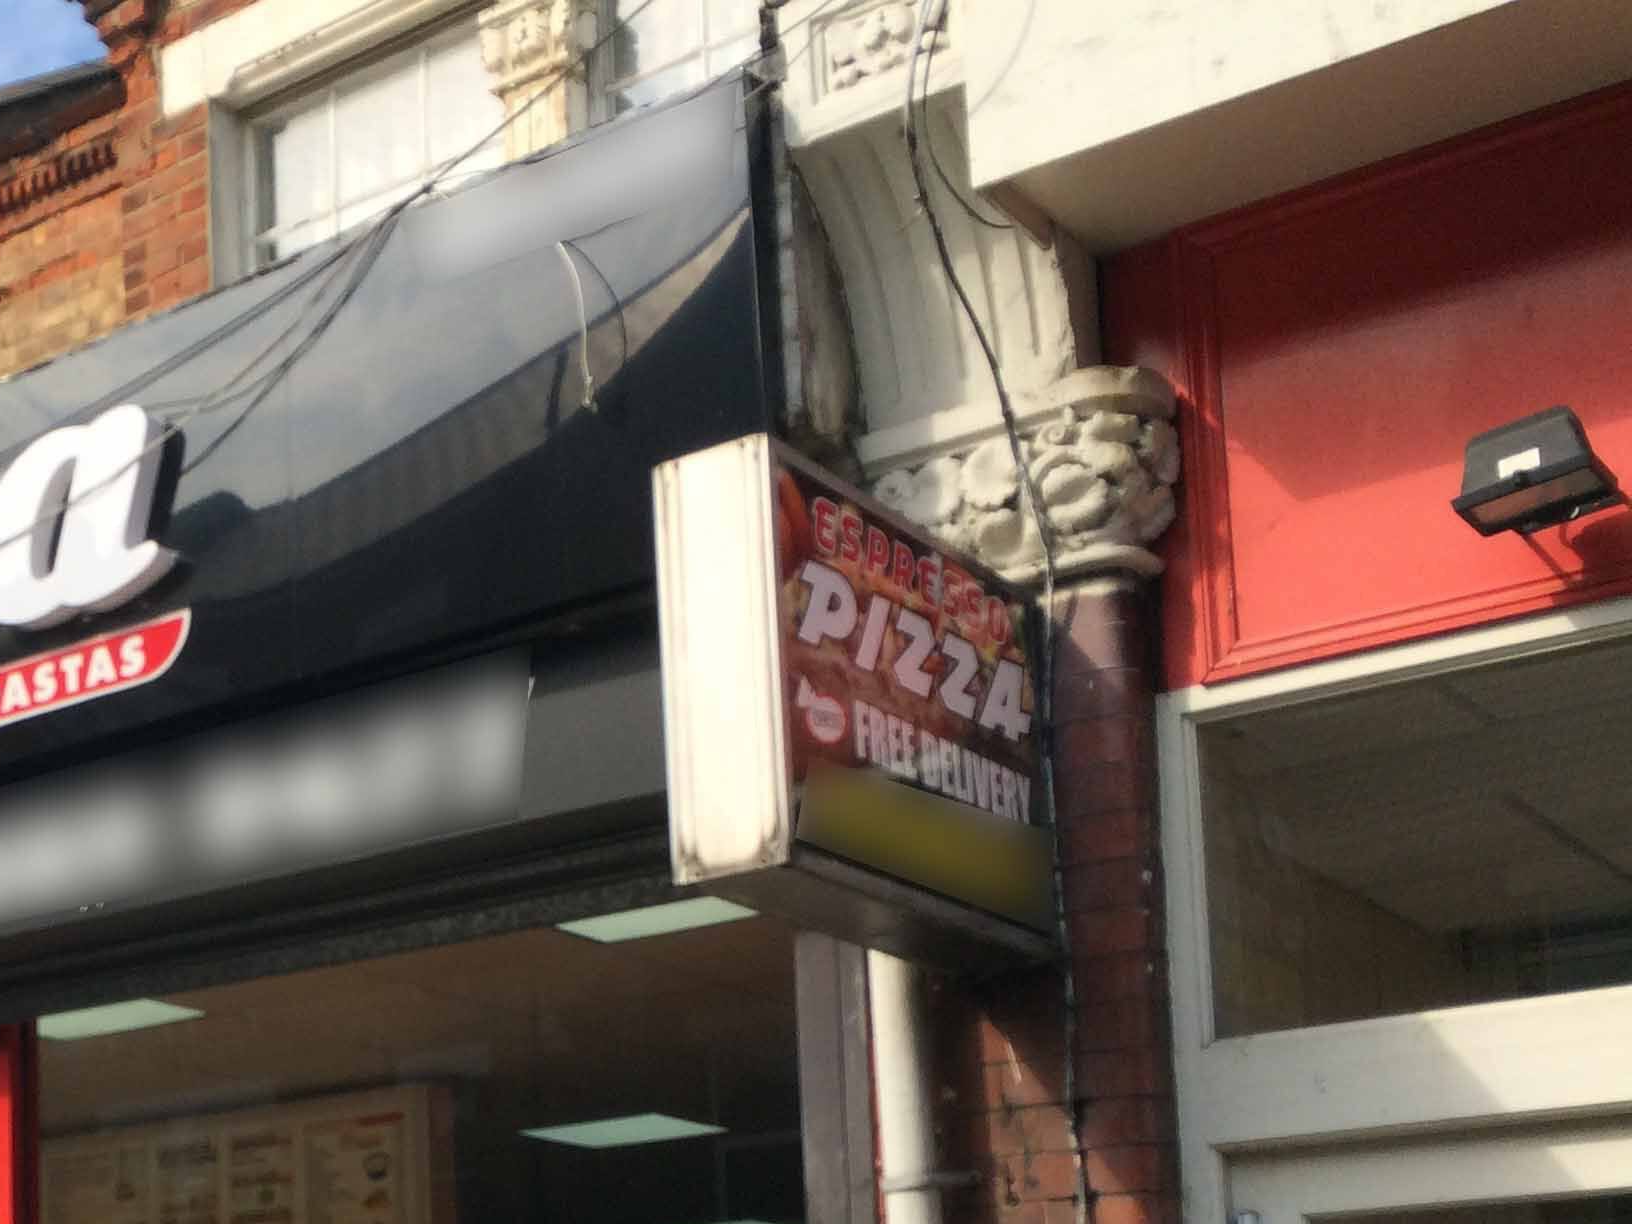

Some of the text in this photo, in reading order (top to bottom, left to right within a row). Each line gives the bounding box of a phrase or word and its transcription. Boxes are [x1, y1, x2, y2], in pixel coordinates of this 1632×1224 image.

[812, 495, 1013, 646] ESPRESSO
[798, 558, 1032, 741] PIZZA
[854, 699, 1032, 825] FREE DELIVERY
